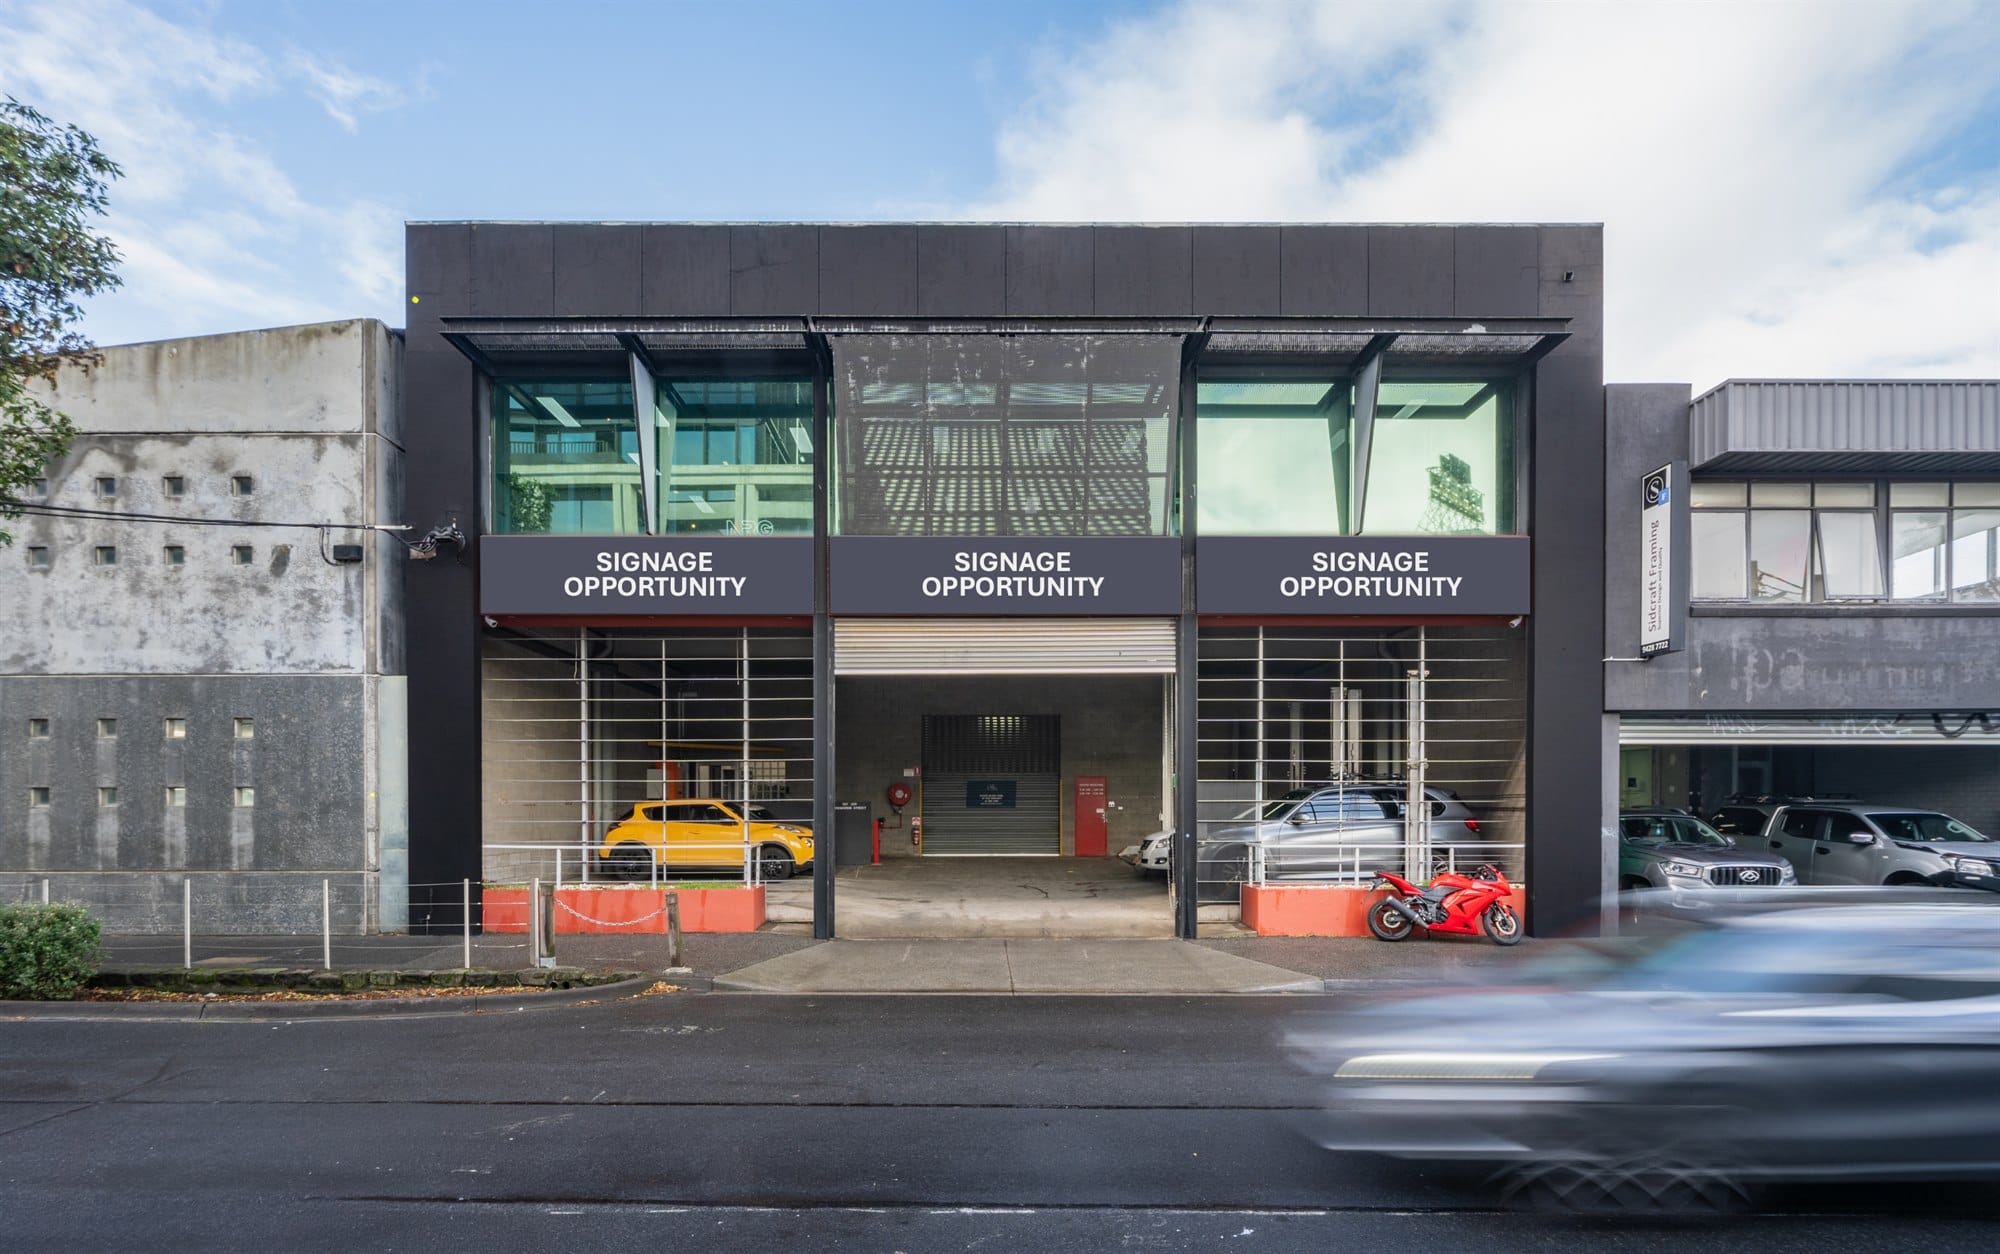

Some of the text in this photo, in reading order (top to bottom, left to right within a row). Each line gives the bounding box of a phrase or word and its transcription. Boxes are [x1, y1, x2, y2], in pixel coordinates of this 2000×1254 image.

[596, 552, 713, 572] SIGNAGE
[954, 552, 1071, 572] SIGNAGE
[1312, 552, 1429, 572] SIGNAGE
[564, 576, 747, 597] OPPORTUNITY
[922, 576, 1105, 597] OPPORTUNITY
[1280, 576, 1463, 597] OPPORTUNITY
[1648, 520, 1660, 633] Sidcraft Framing
